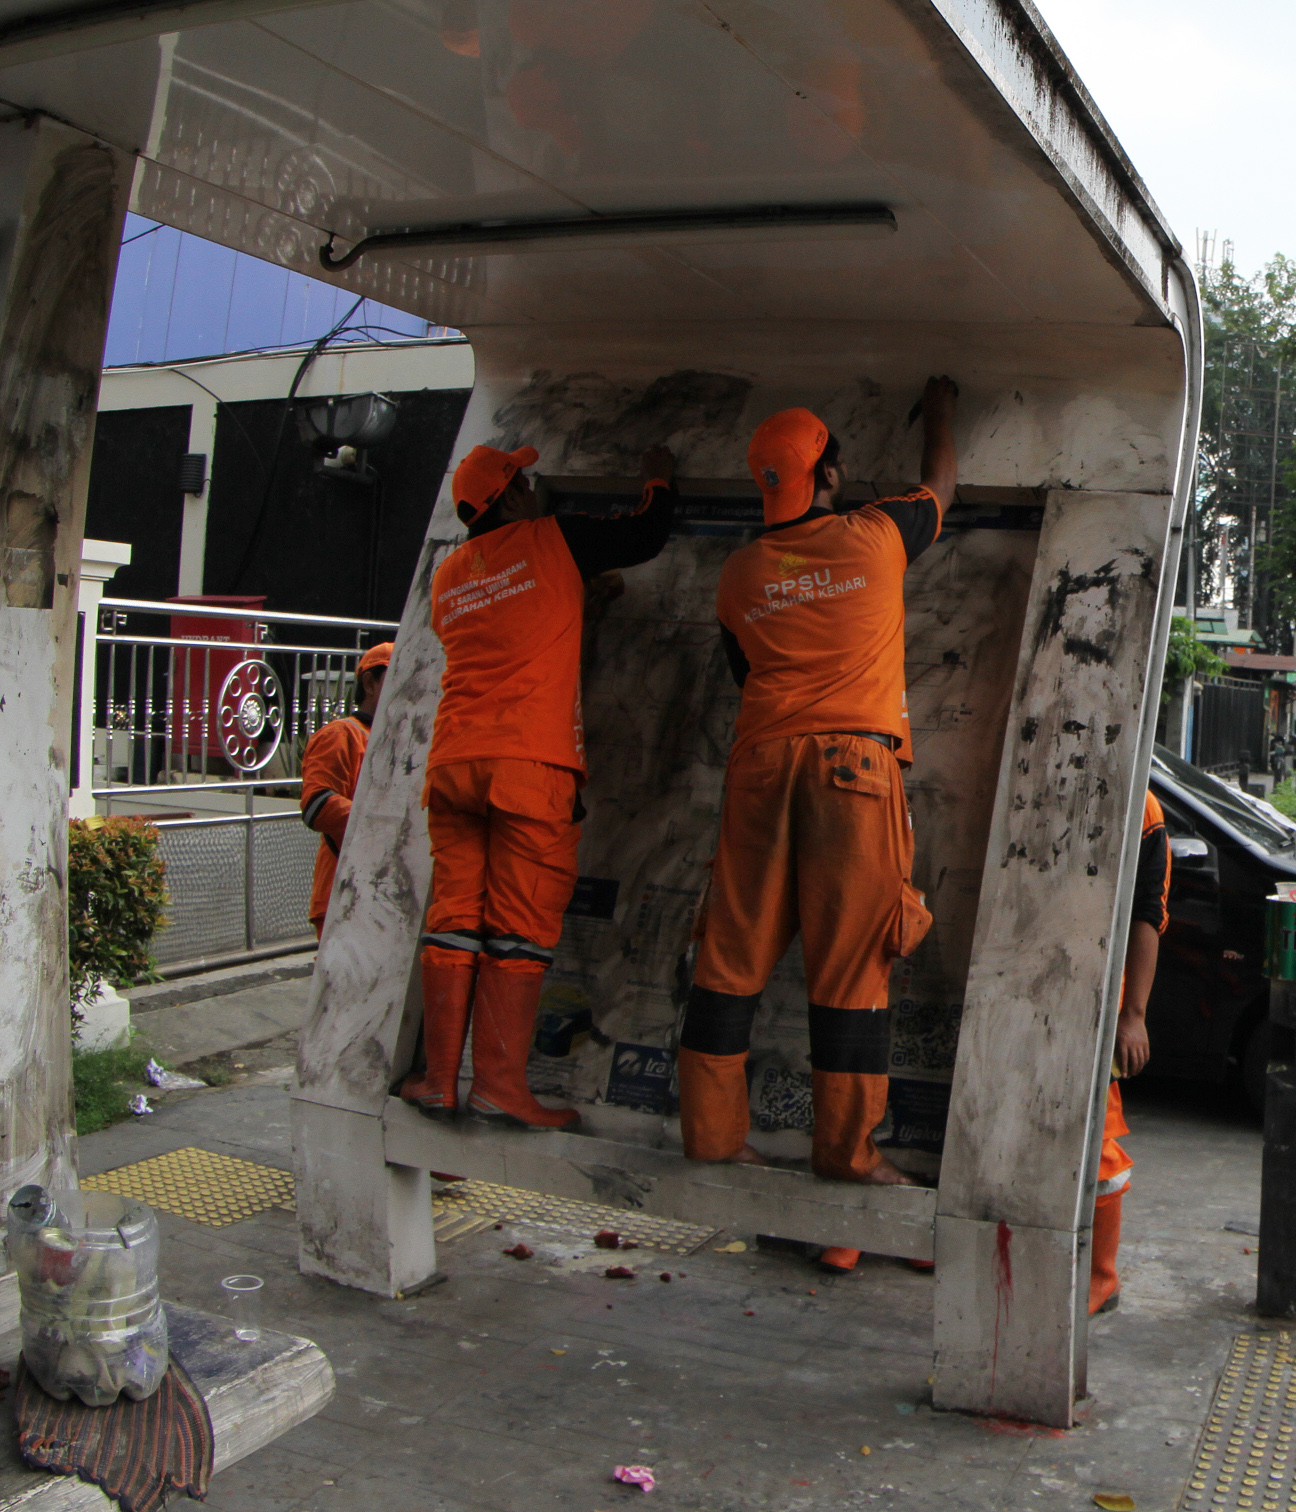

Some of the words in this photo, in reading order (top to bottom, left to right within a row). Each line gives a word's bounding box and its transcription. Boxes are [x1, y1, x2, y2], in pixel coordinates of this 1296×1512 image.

[480, 559, 528, 586] PRASARANA
[764, 568, 831, 601] PPSU
[456, 589, 486, 606] SARANA
[485, 577, 511, 595] UMUM
[493, 578, 537, 602] KENARI
[744, 590, 815, 624] KELURAHAN
[818, 575, 867, 599] KENARI
